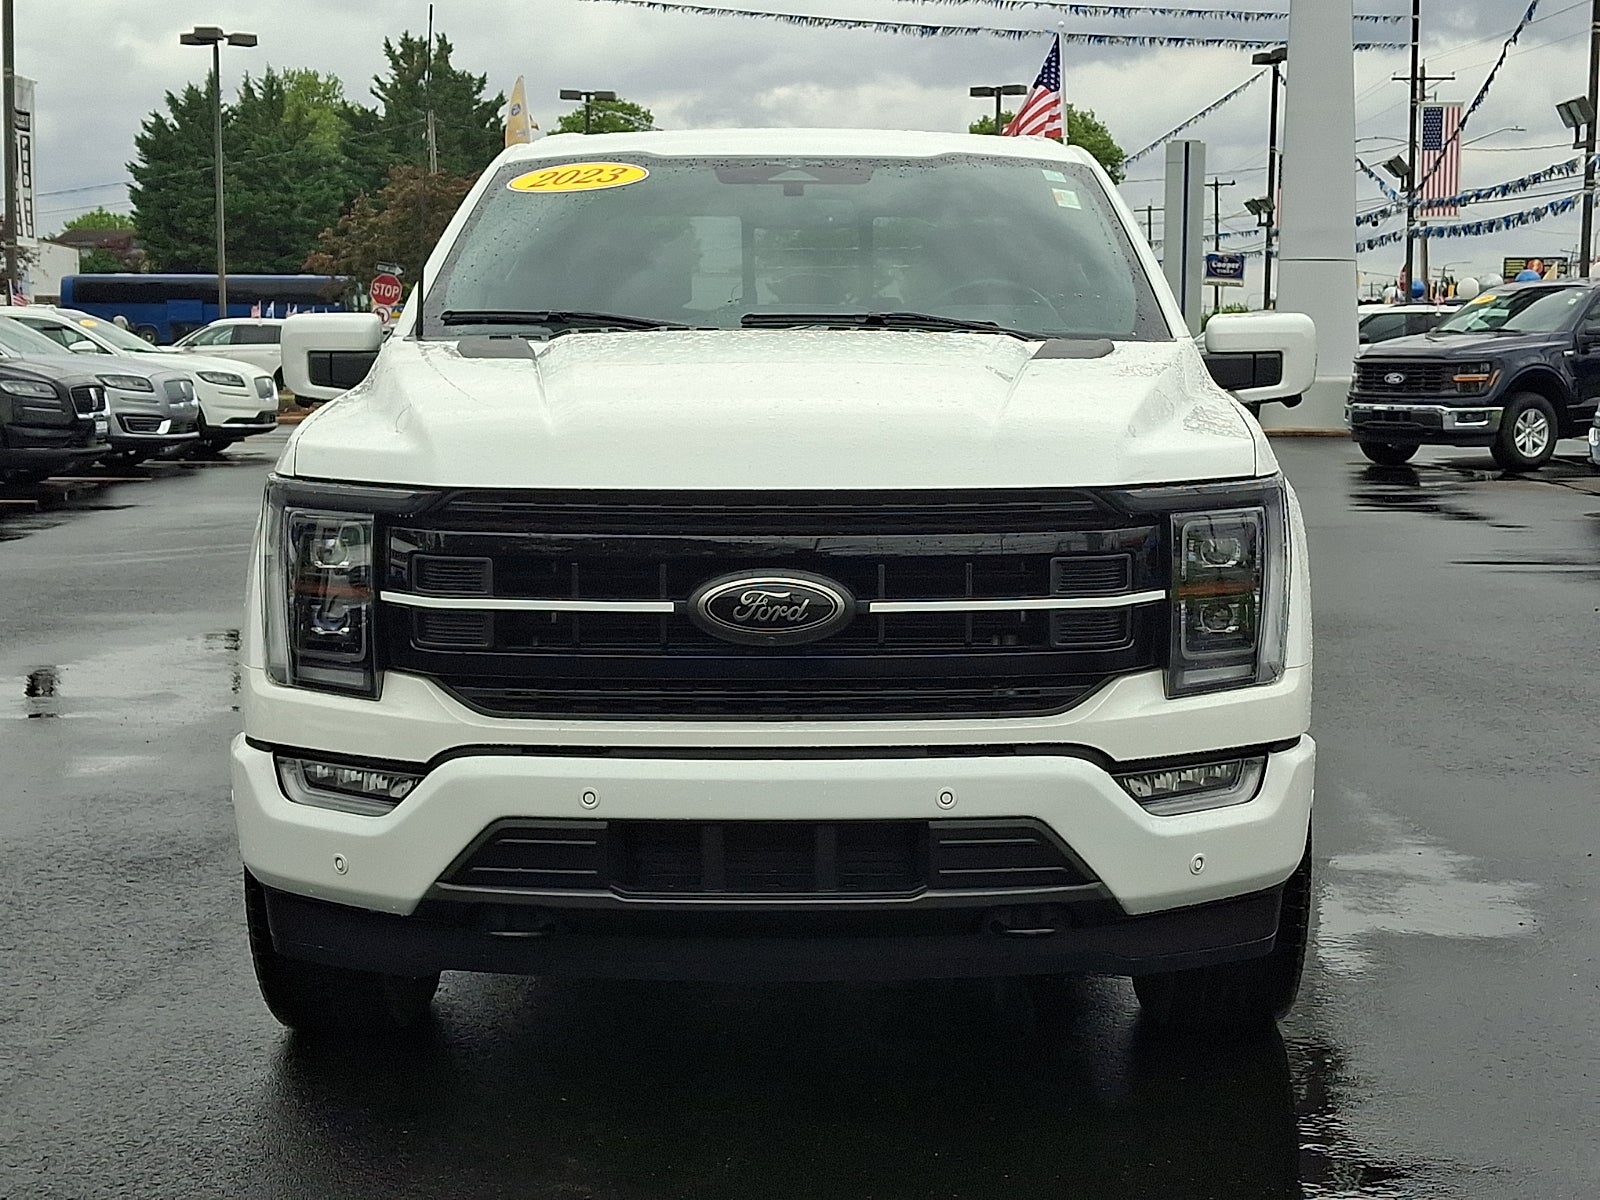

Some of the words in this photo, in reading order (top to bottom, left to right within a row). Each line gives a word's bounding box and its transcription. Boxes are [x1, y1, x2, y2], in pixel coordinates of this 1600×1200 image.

[528, 167, 628, 188] 2023
[1211, 260, 1239, 270] Cooper
[373, 283, 399, 298] STOP
[733, 590, 810, 622] Ford
